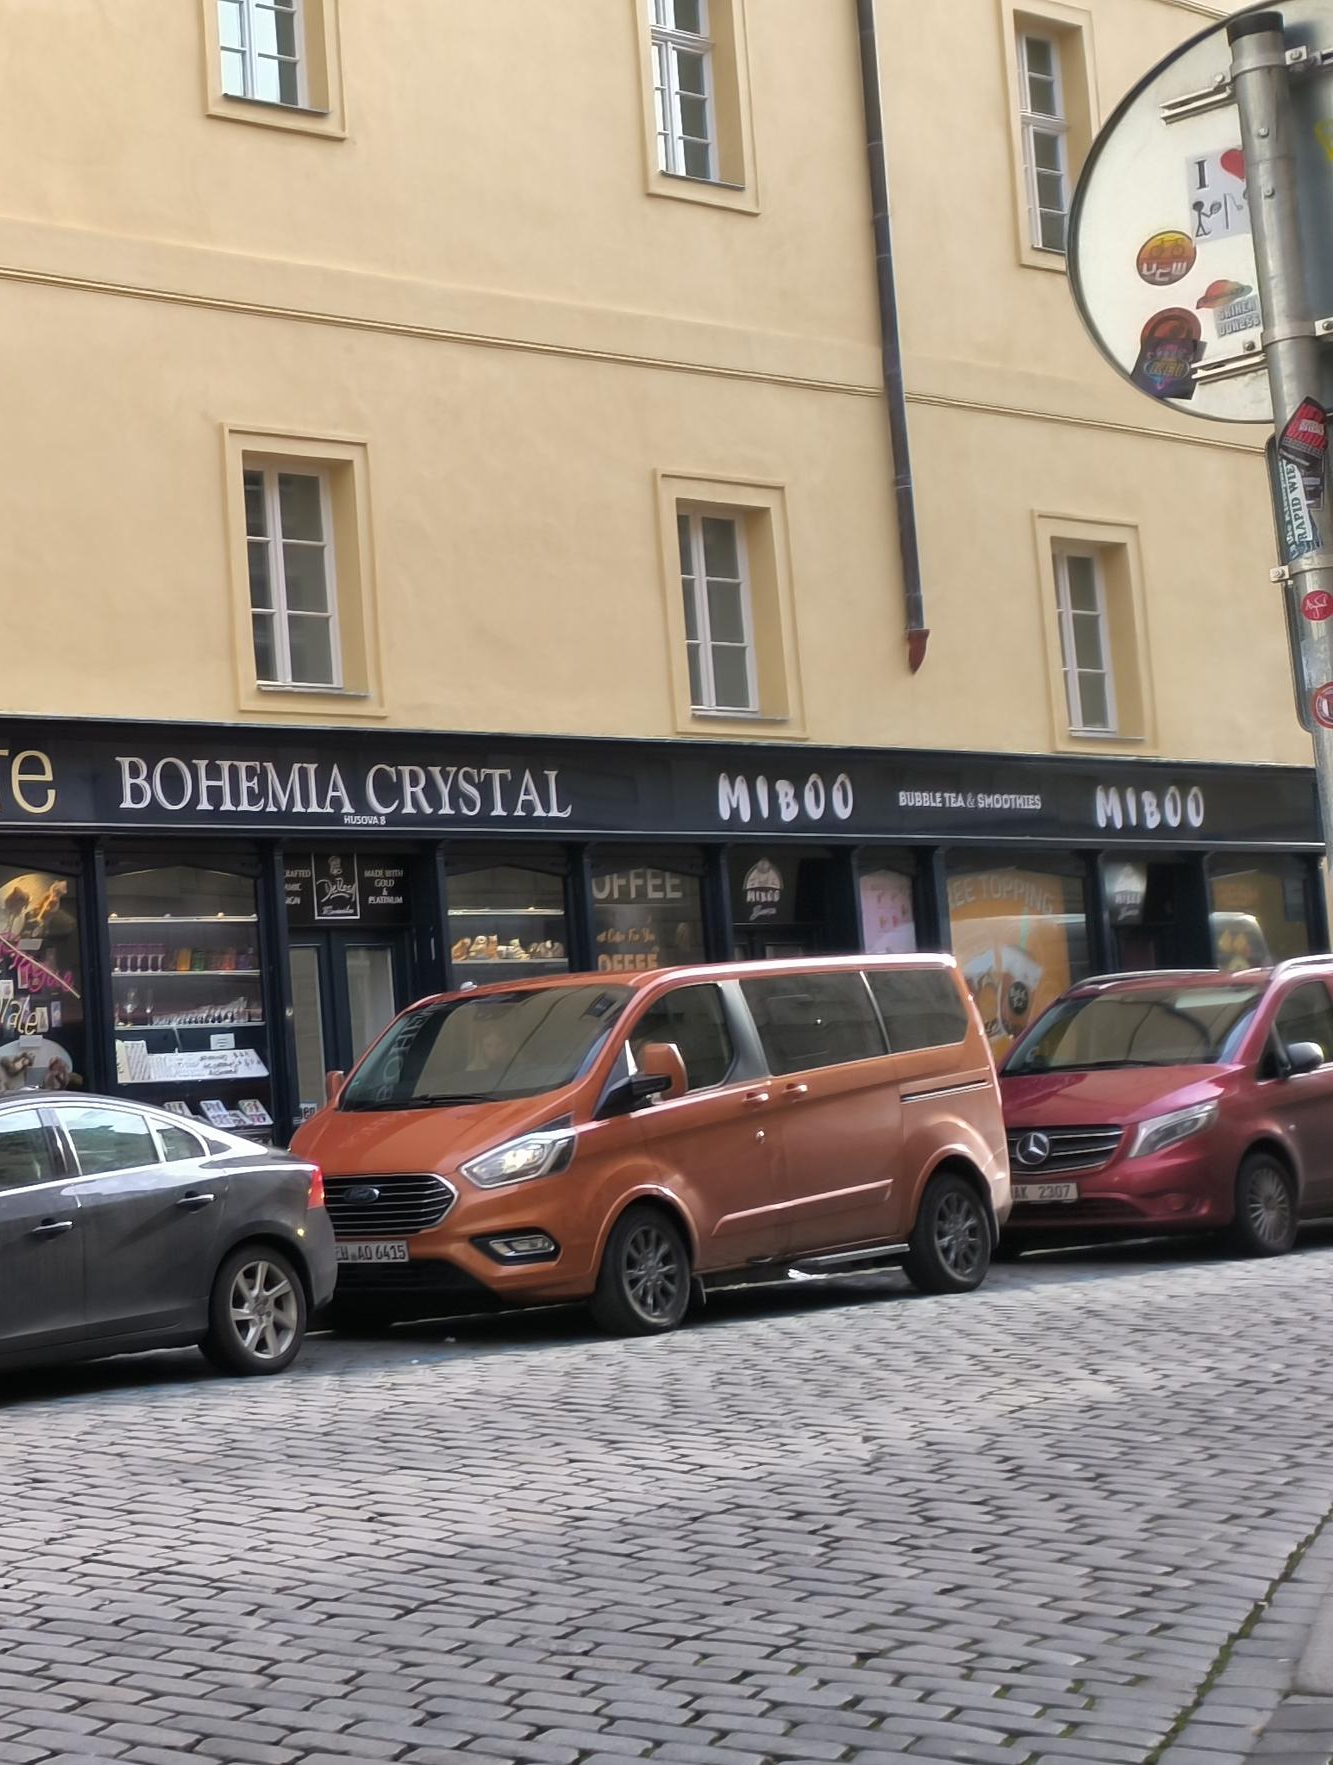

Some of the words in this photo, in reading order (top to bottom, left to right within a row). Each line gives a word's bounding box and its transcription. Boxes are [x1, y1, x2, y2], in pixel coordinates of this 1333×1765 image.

[1194, 160, 1209, 189] I
[1290, 497, 1308, 542] RAPID
[115, 756, 355, 814] BOHEMIA
[365, 763, 572, 818] CRYSTAL
[718, 772, 854, 823] MIBOO
[898, 791, 942, 807] BUBBLE
[944, 793, 965, 808] TEA
[967, 793, 975, 808] &
[977, 793, 1042, 809] SMOOTHIES
[1095, 785, 1205, 829] MIBOO
[344, 815, 379, 825] HUSOVA
[380, 816, 386, 825] 8
[374, 879, 395, 888] GOLD
[368, 896, 404, 905] PLATINUM
[1038, 1185, 1071, 1199] 2307
[376, 1245, 406, 1260] 6415
